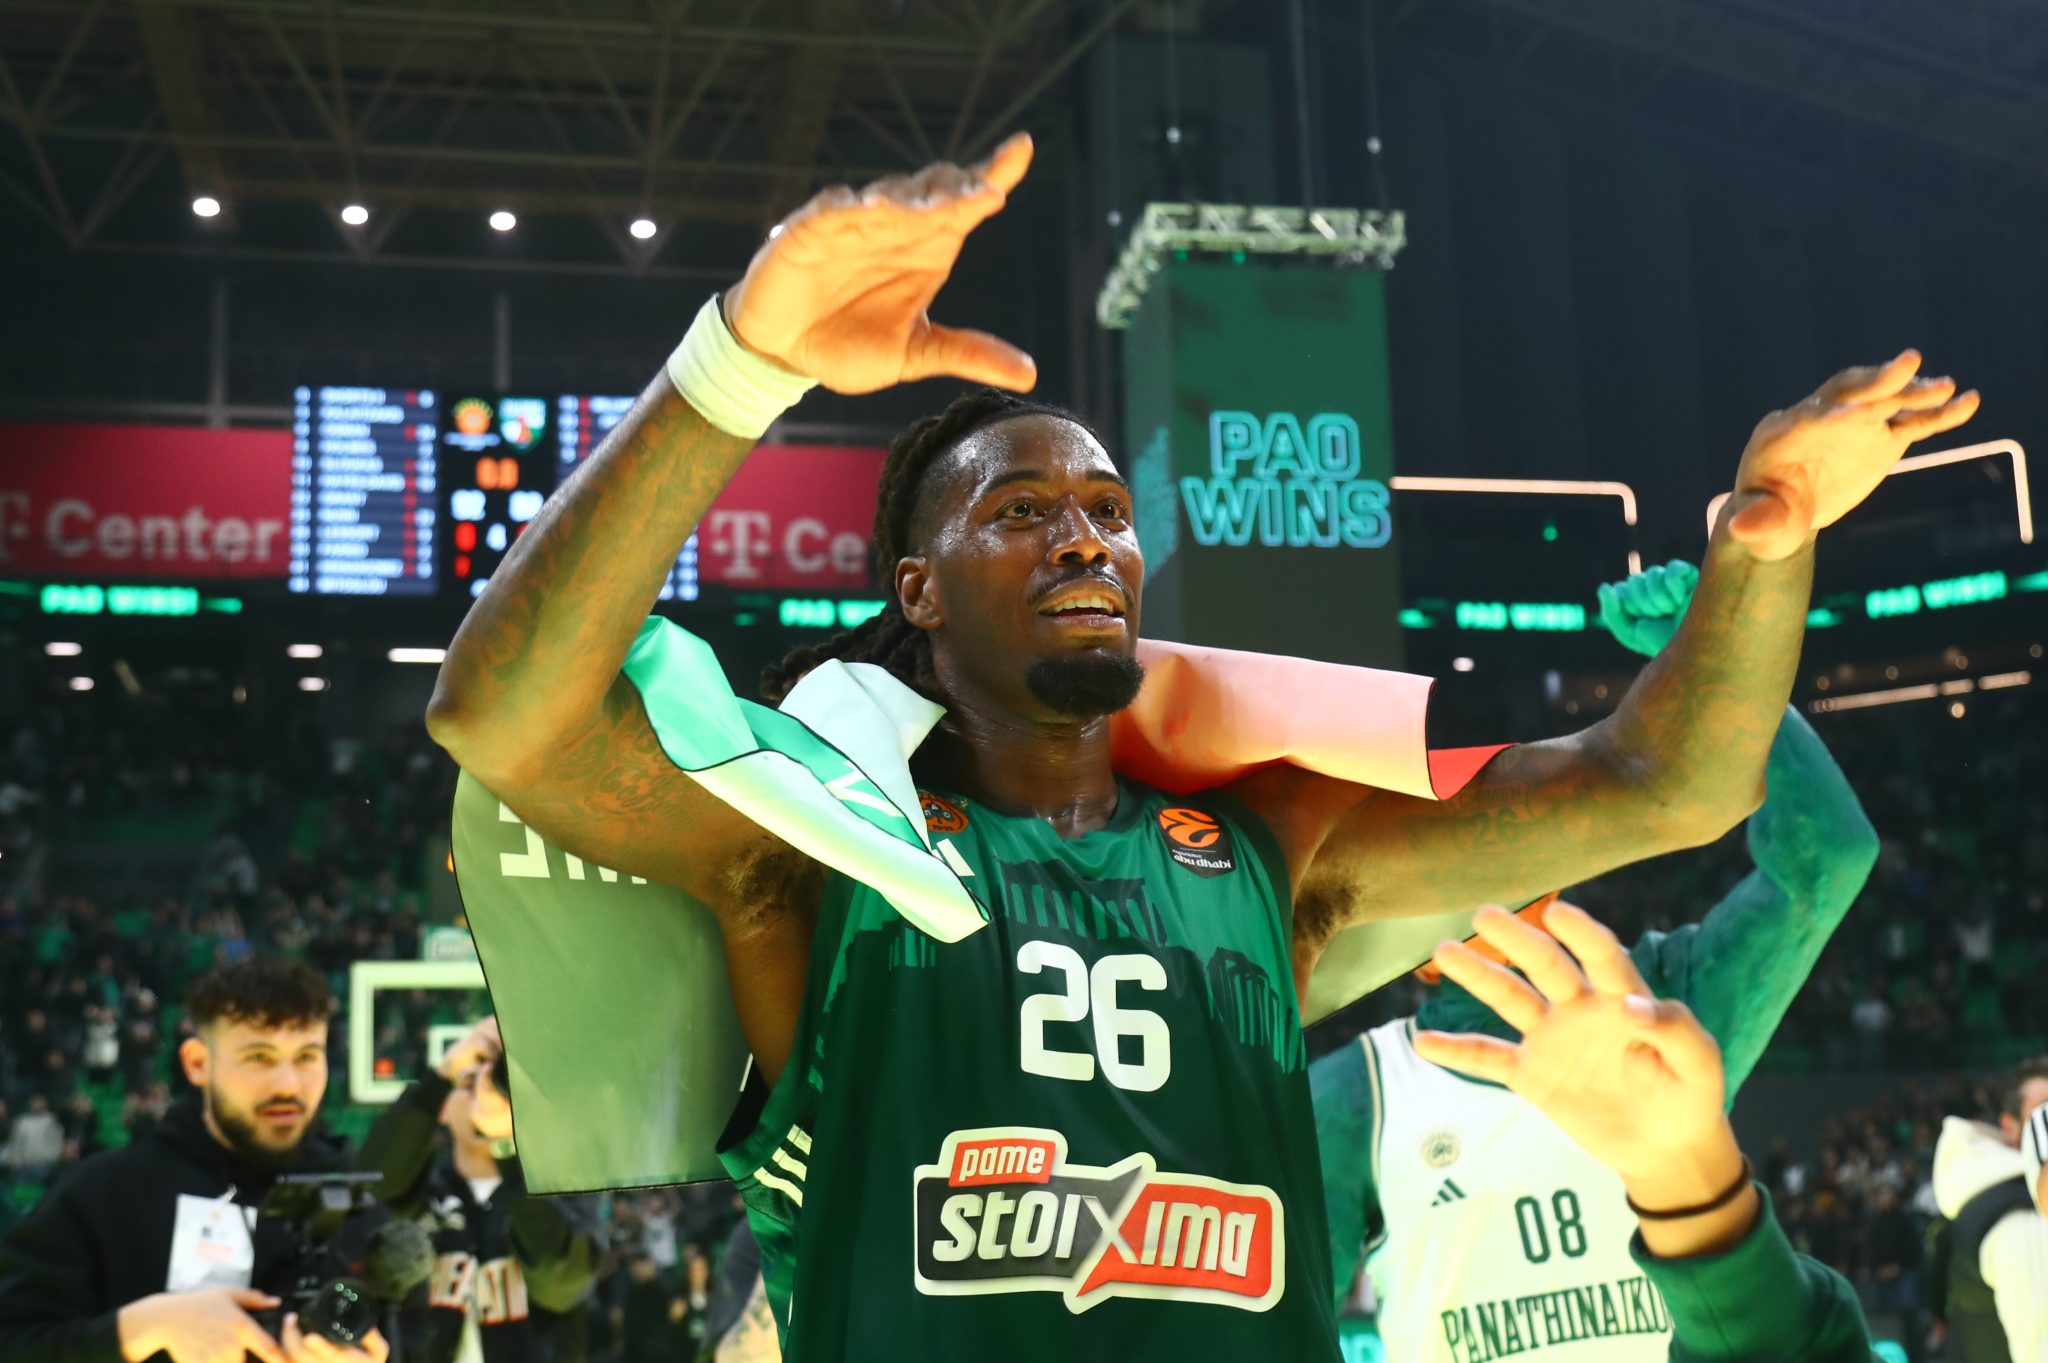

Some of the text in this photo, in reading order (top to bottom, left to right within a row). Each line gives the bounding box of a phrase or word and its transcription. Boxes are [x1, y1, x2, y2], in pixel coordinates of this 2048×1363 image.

[1209, 410, 1361, 481] PAO
[47, 497, 283, 563] Center
[1179, 475, 1392, 548] WINS
[1174, 854, 1231, 868] abu dhabi
[1017, 940, 1171, 1093] 26
[958, 1145, 1046, 1182] pame
[1514, 1187, 1588, 1265] 08
